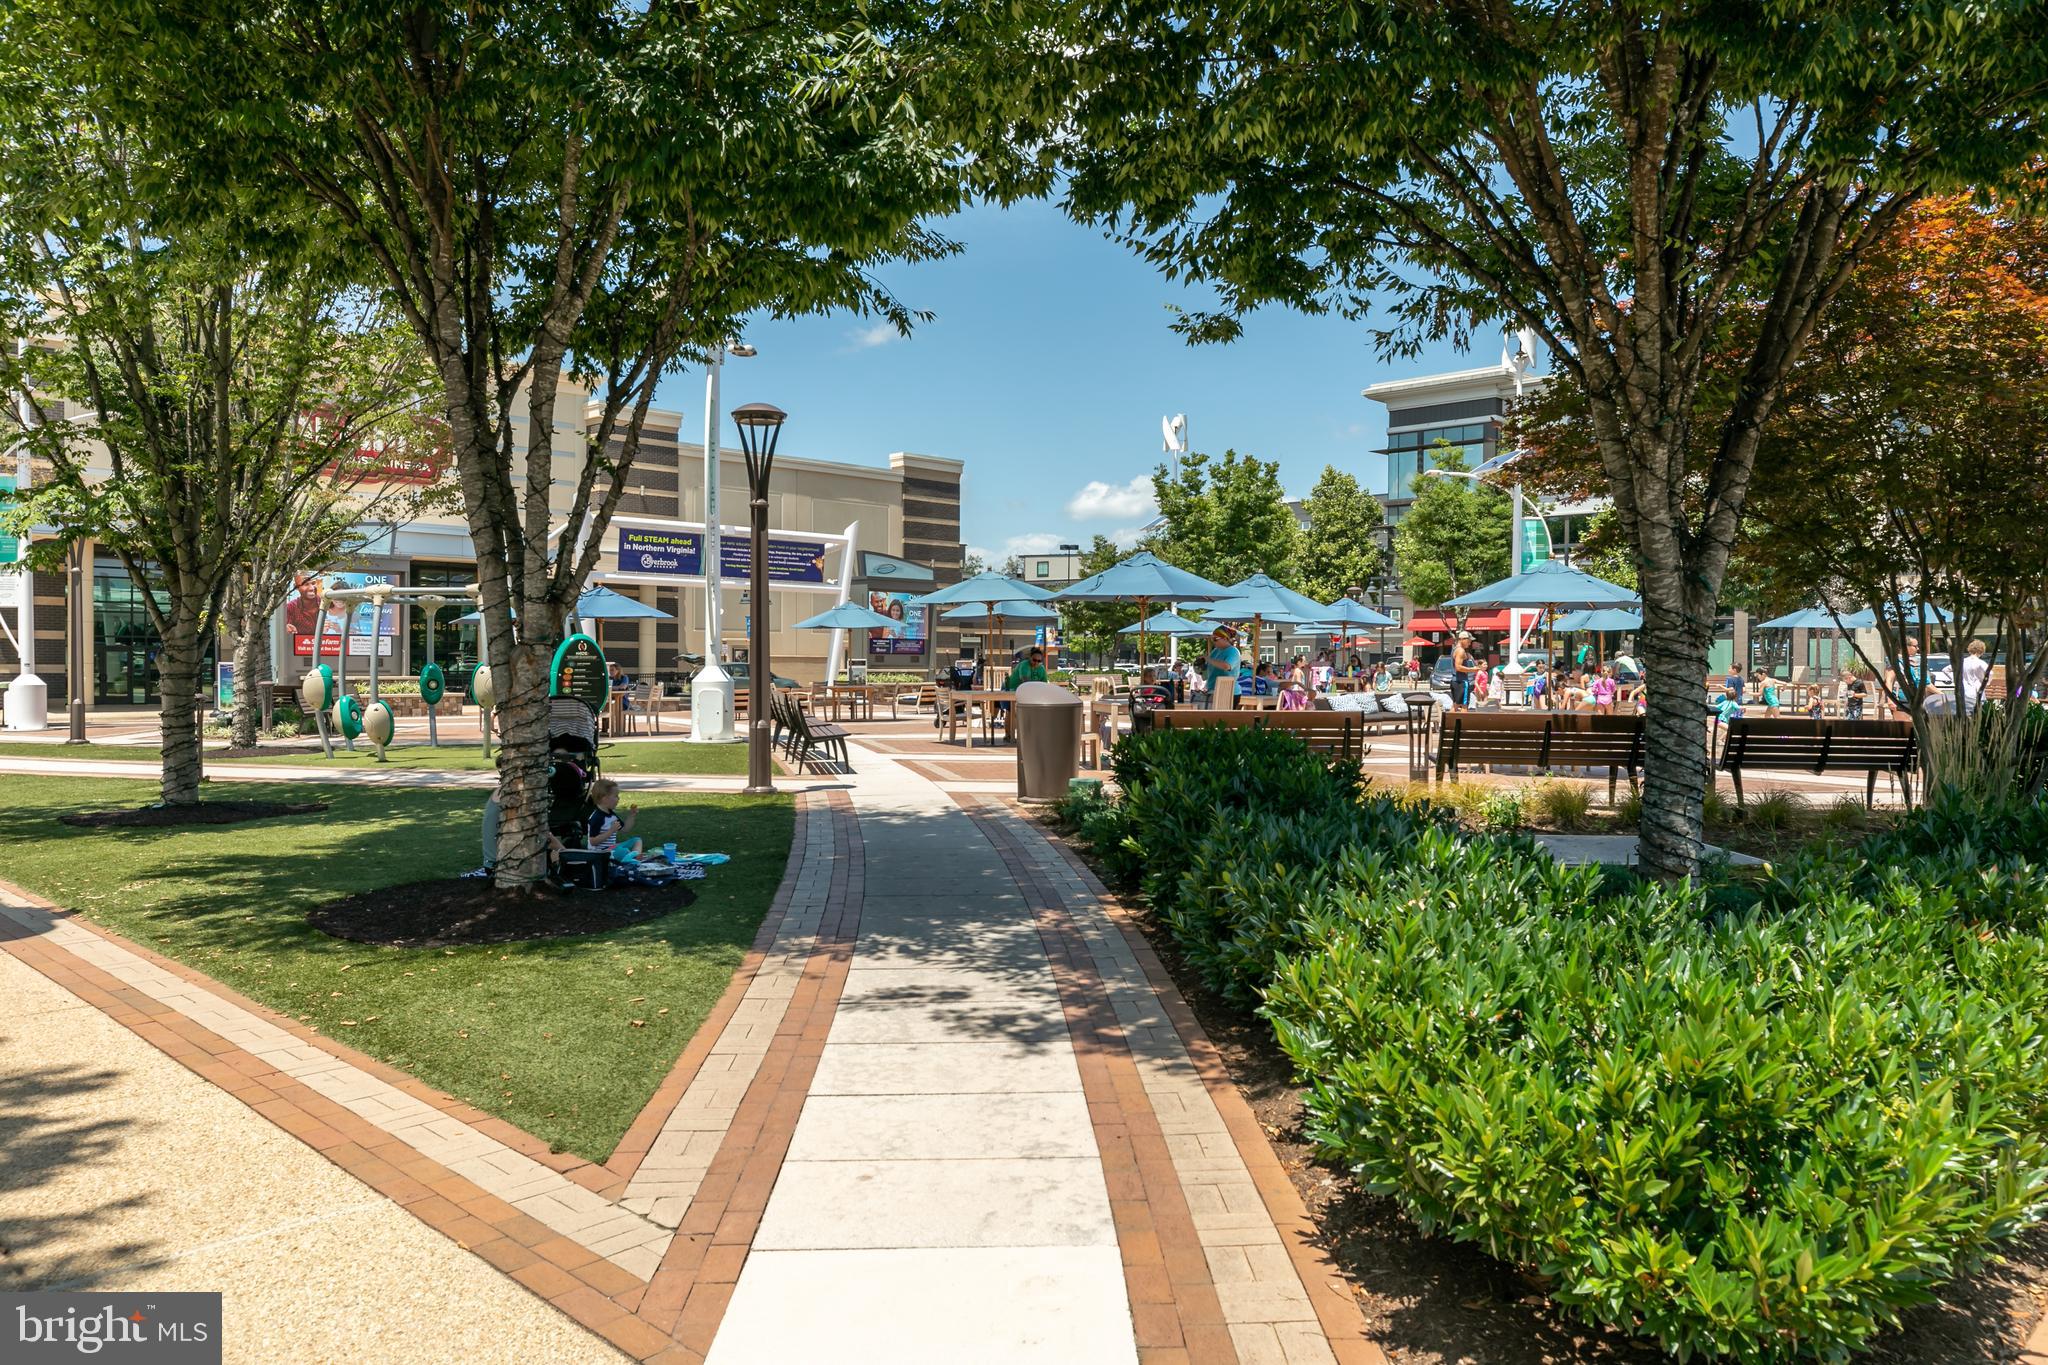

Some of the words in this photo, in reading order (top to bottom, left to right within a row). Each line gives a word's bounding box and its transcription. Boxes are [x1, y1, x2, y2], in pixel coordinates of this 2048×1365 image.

[628, 534, 642, 542] Full
[643, 536, 669, 544] STEAM
[623, 542, 631, 550] in
[632, 543, 665, 552] Northern
[666, 546, 696, 555] Virginia!
[365, 575, 388, 584] ONE
